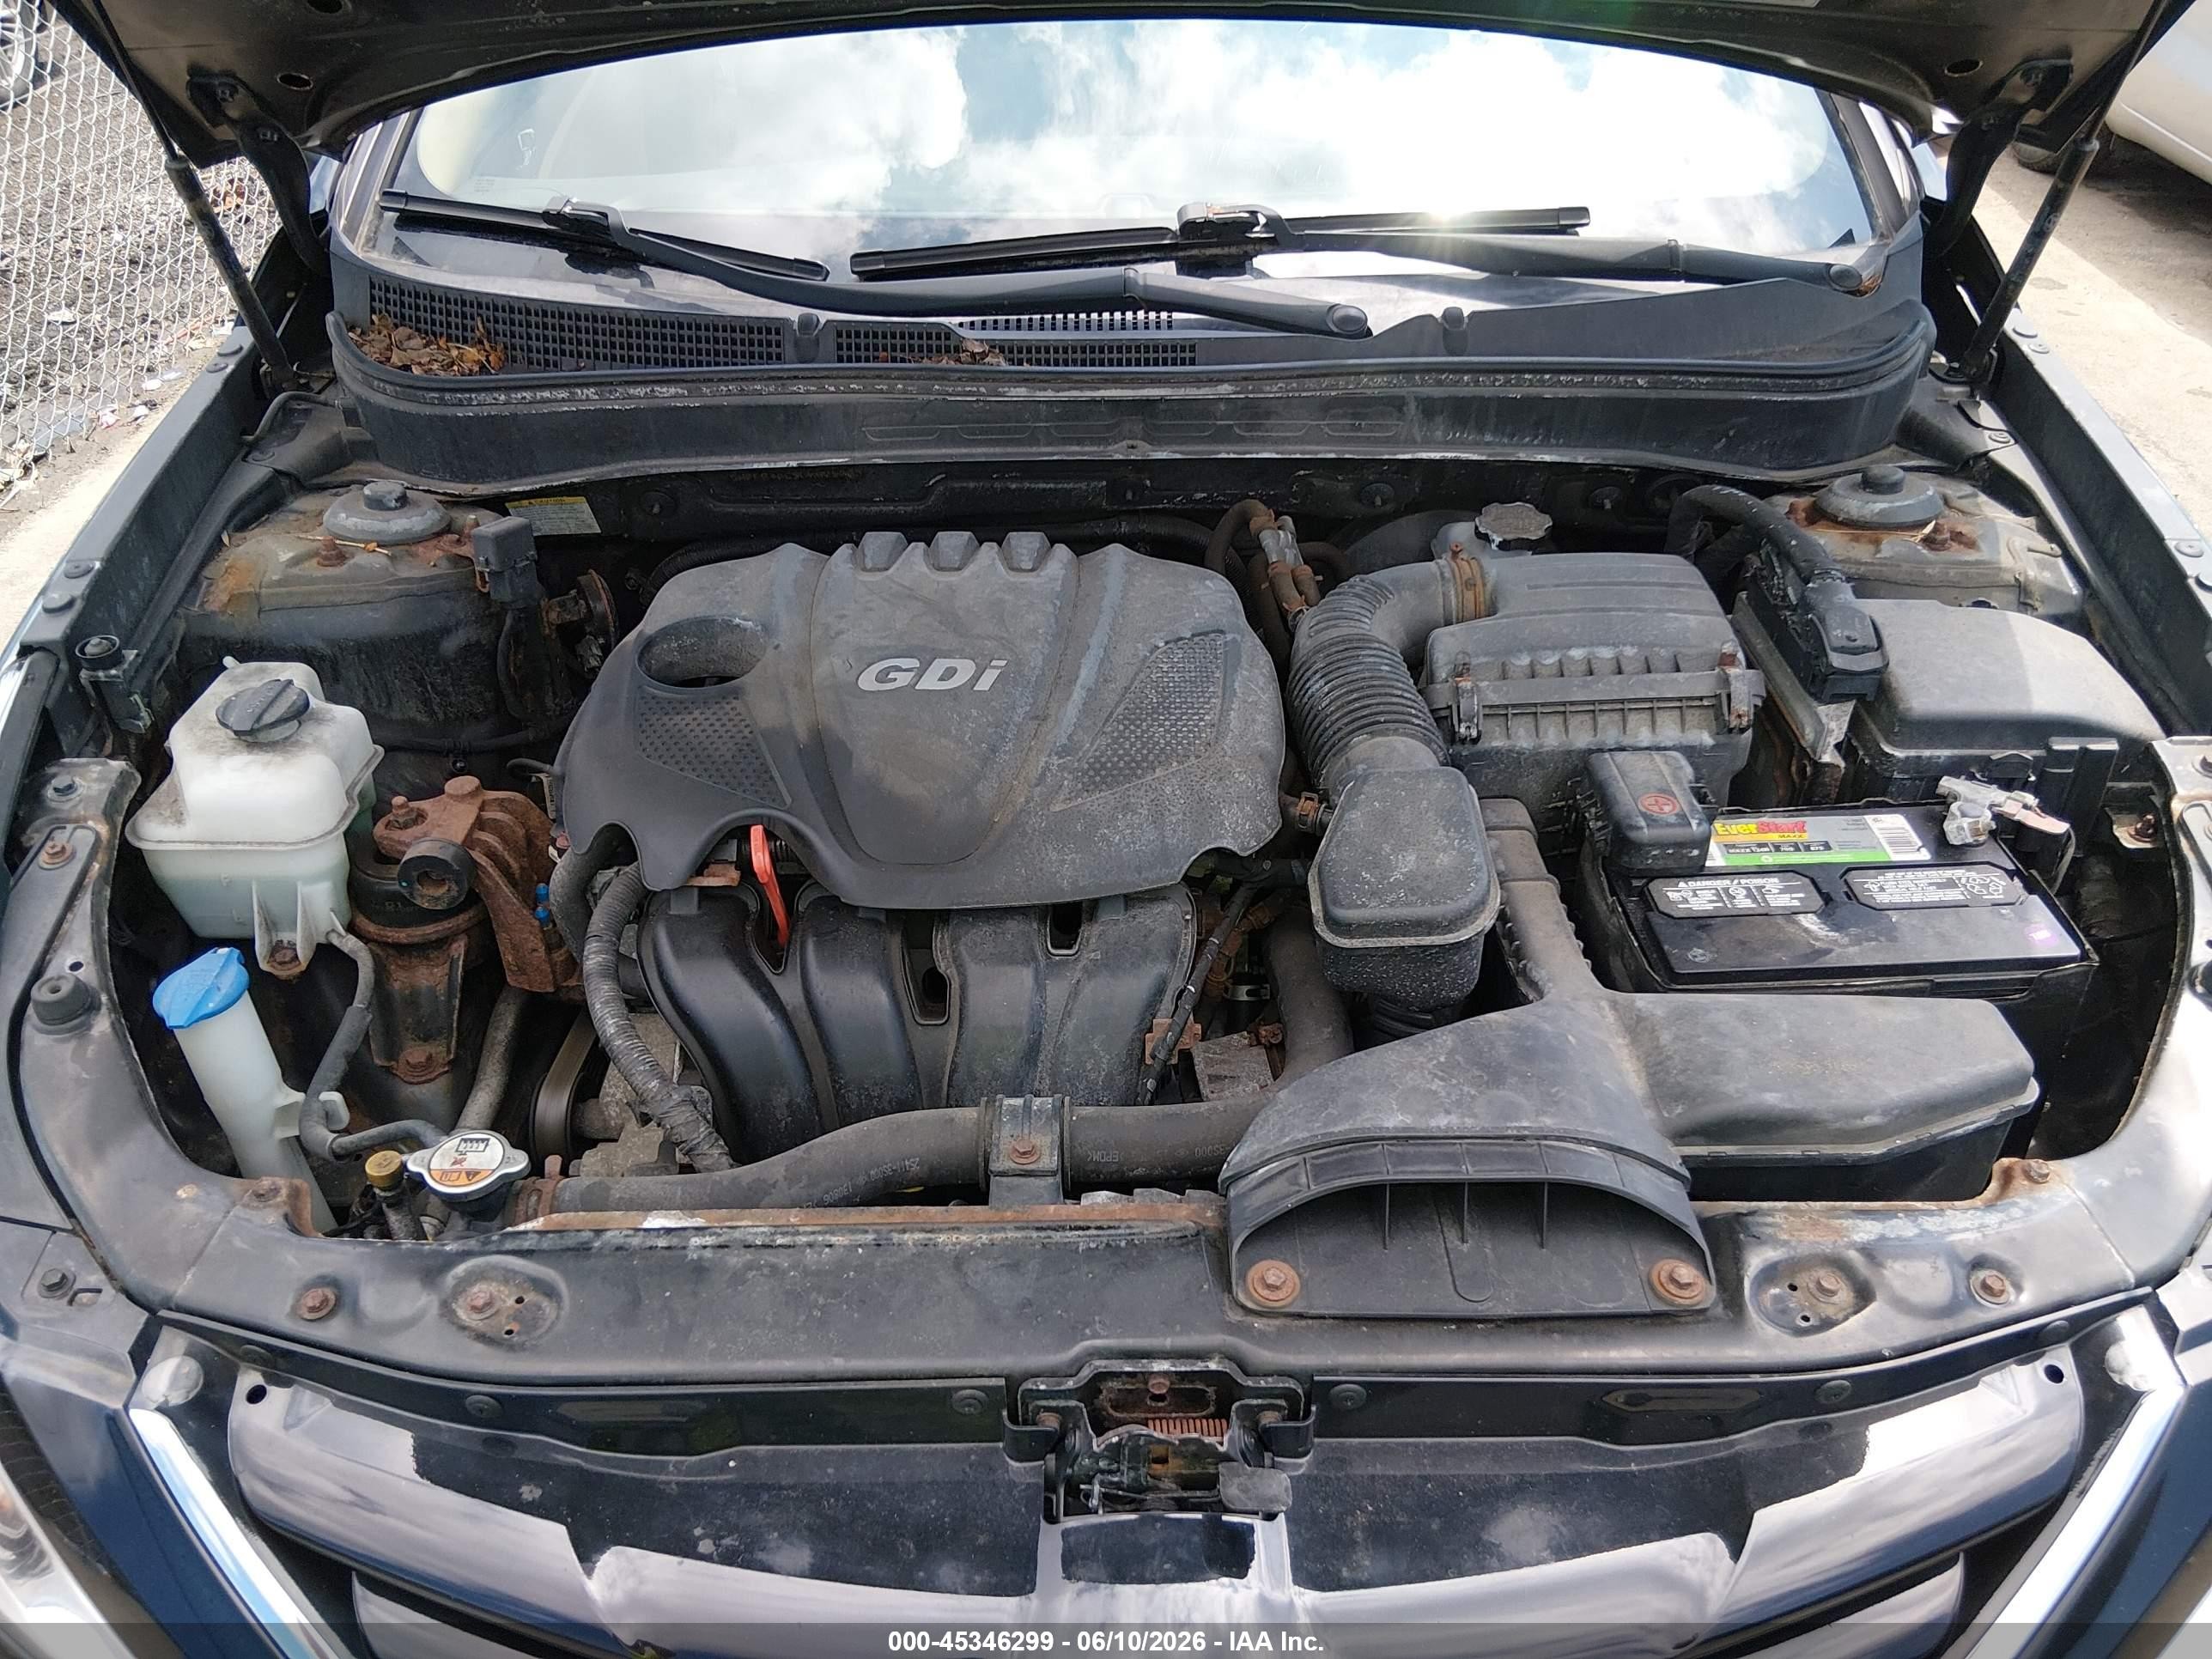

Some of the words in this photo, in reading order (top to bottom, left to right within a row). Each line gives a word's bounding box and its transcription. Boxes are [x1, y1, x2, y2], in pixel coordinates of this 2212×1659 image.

[857, 657, 1008, 691] GDi
[1714, 822, 1808, 836] EverStart
[1687, 879, 1731, 888] DANGER
[1194, 1145, 1231, 1158] -3S000
